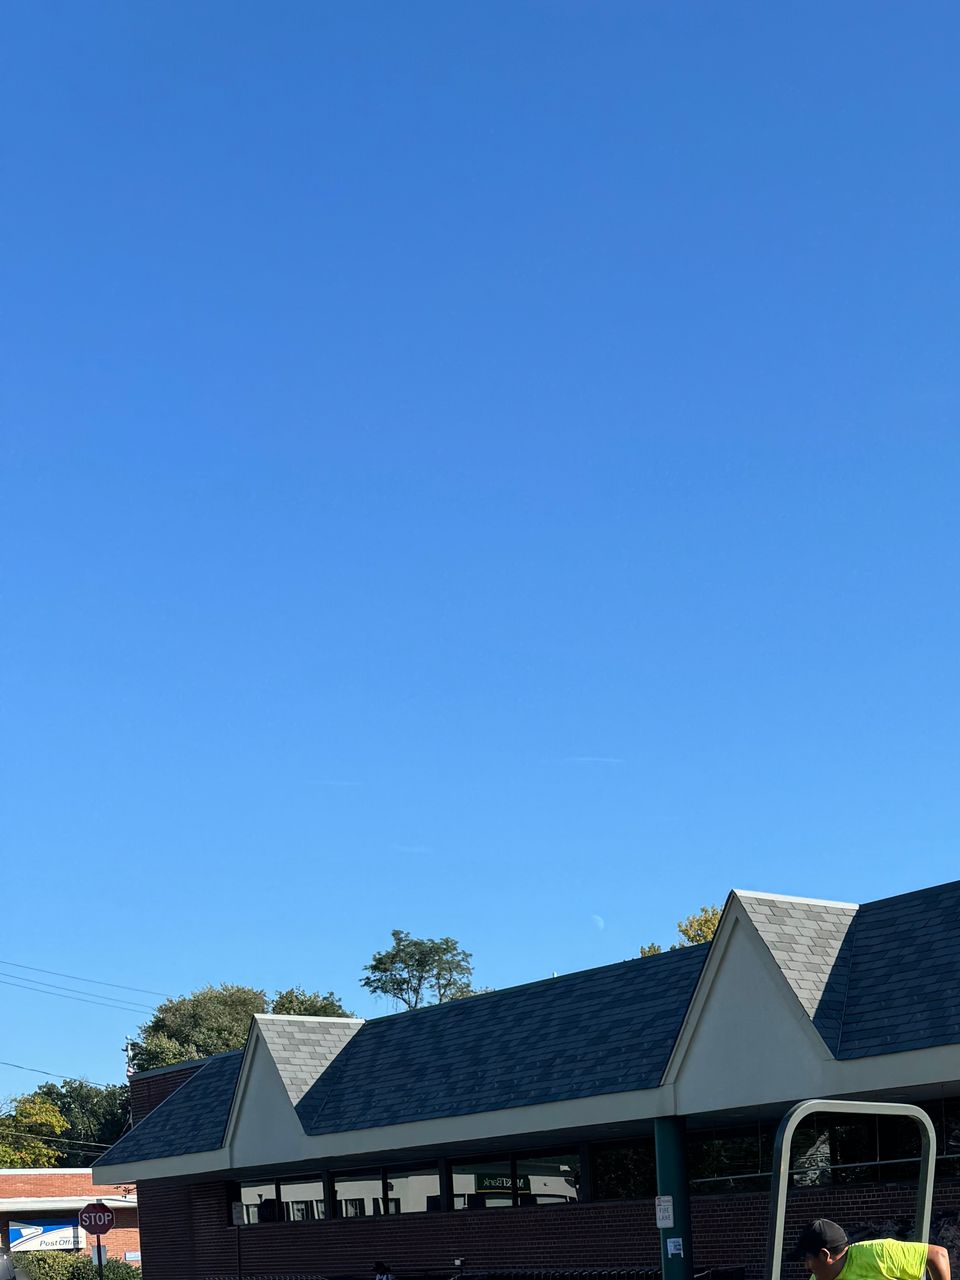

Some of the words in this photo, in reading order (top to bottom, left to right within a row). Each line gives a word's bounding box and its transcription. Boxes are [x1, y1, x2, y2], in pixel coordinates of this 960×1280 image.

[82, 1212, 113, 1226] STOP
[39, 1240, 58, 1248] Post
[58, 1239, 83, 1247] Offie
